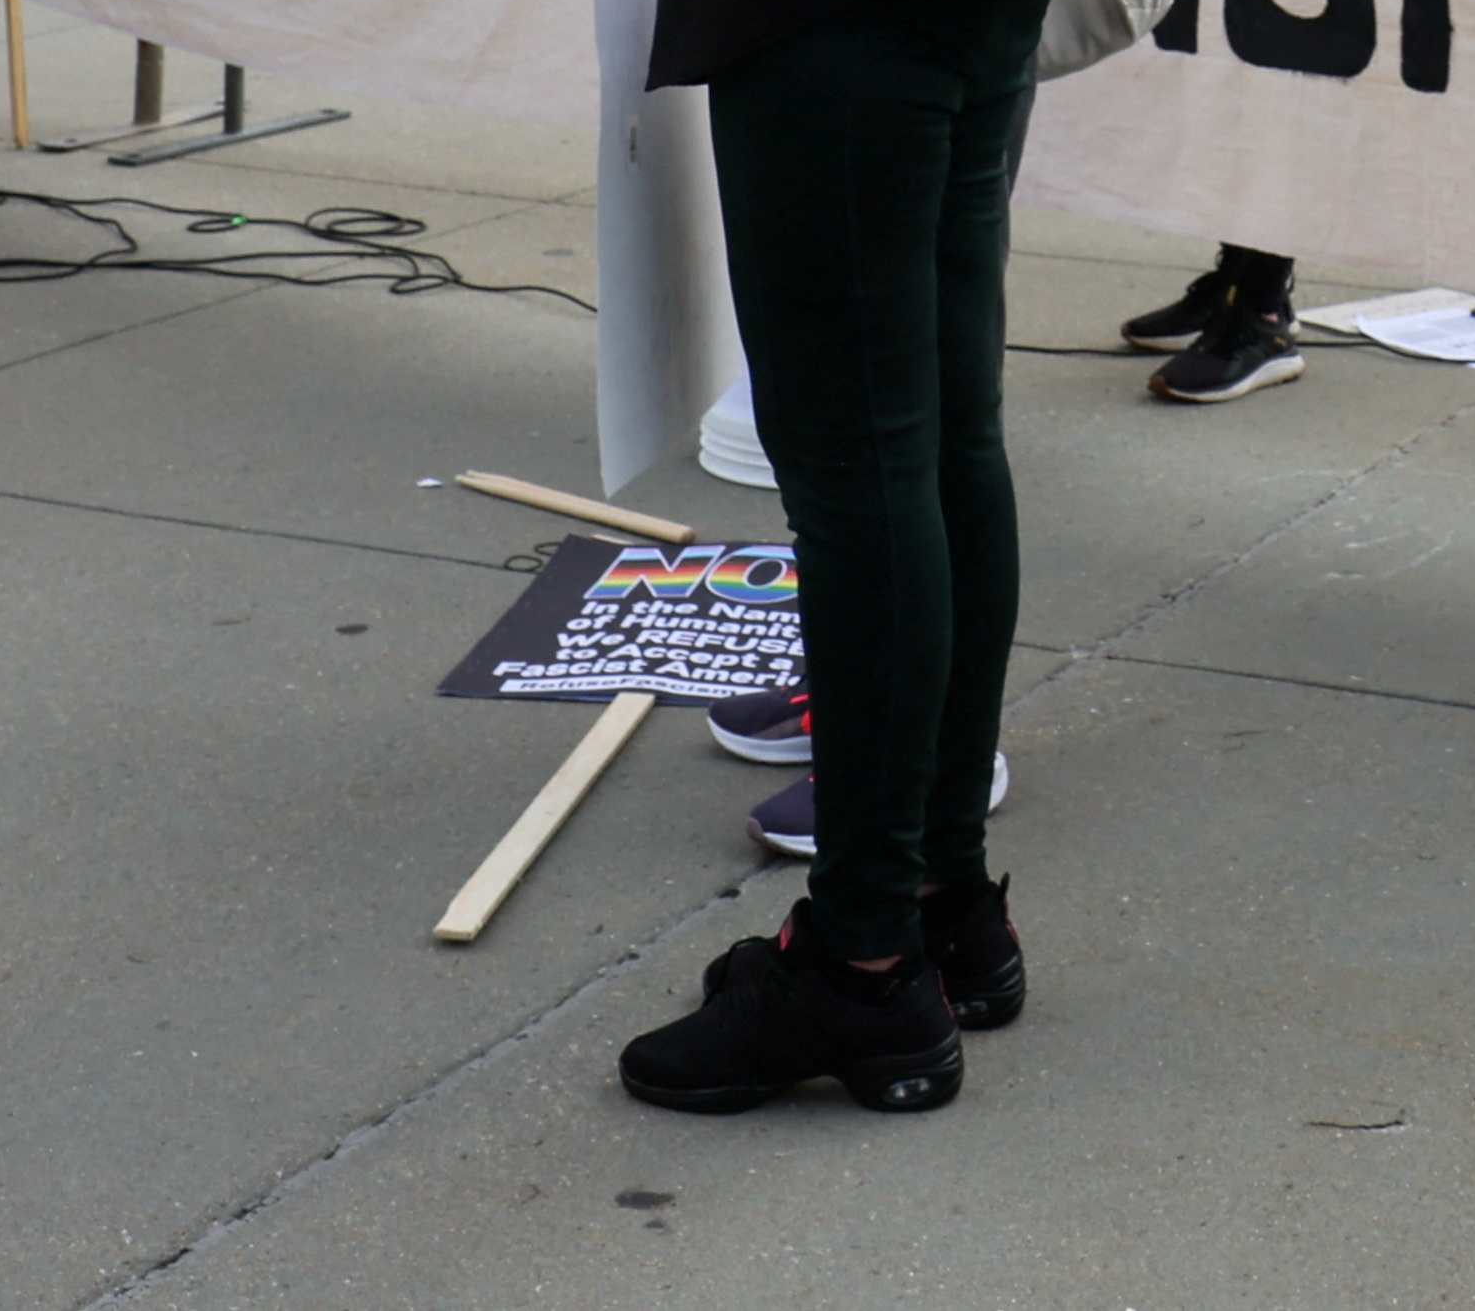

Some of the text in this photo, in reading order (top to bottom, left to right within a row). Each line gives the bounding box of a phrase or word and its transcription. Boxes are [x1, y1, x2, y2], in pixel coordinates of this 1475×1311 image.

[580, 599, 801, 625] In the Nam
[556, 630, 626, 648] We
[566, 613, 801, 639] of Humanit
[556, 643, 794, 670] to Accept a
[492, 658, 802, 687] Fascist Ameri
